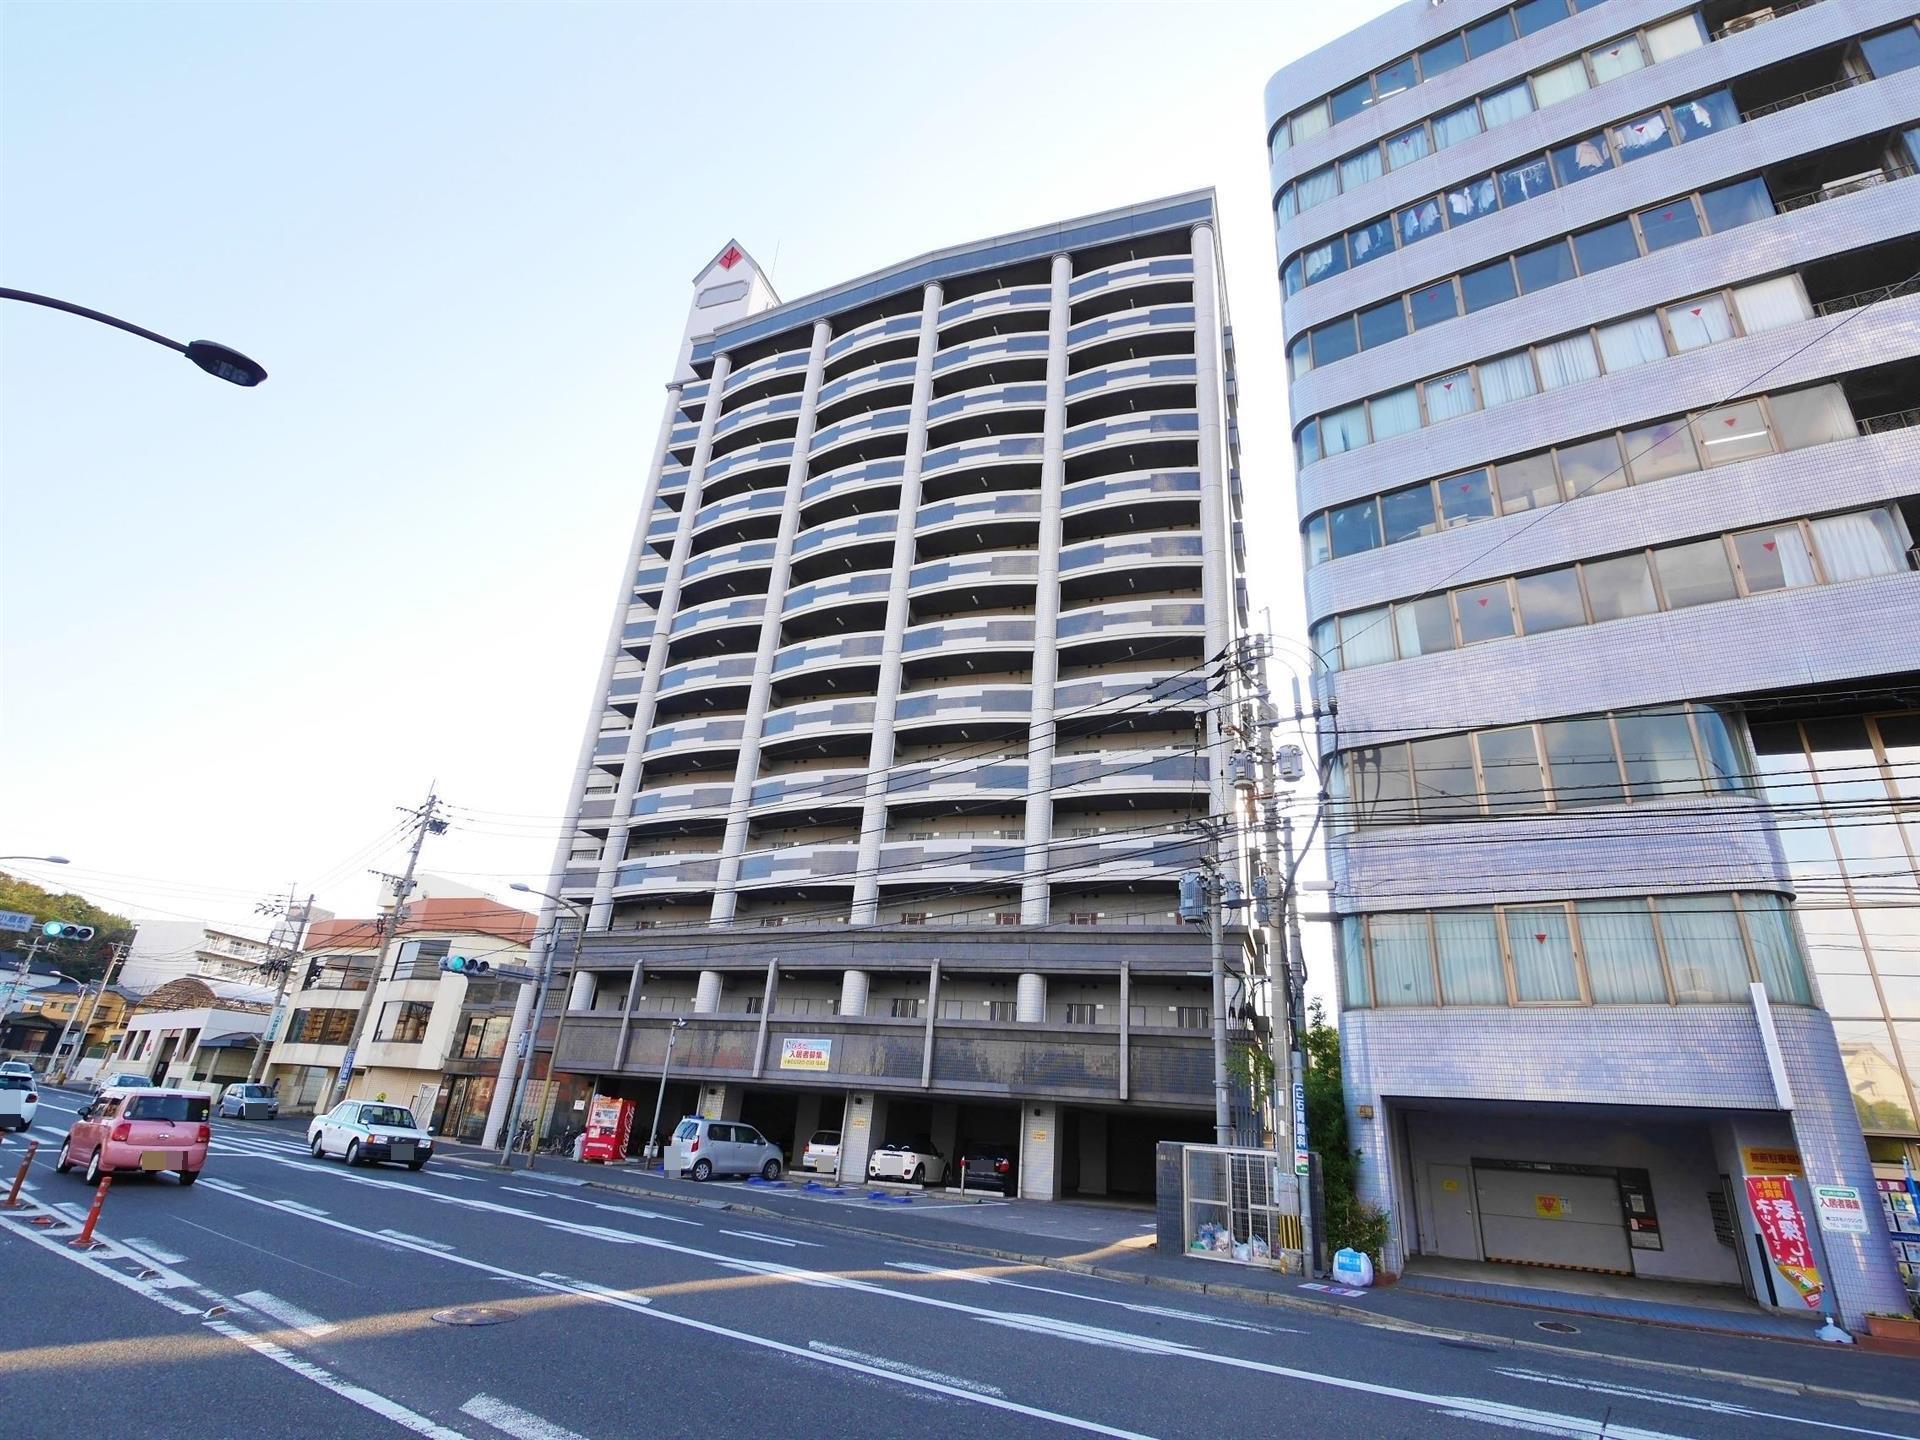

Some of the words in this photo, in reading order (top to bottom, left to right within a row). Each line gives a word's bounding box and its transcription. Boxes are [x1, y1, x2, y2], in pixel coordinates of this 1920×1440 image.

[789, 1050, 823, 1059] 入居者募集
[619, 1103, 636, 1159] Coca-Cola
[1820, 1197, 1860, 1210] 入居者募集
